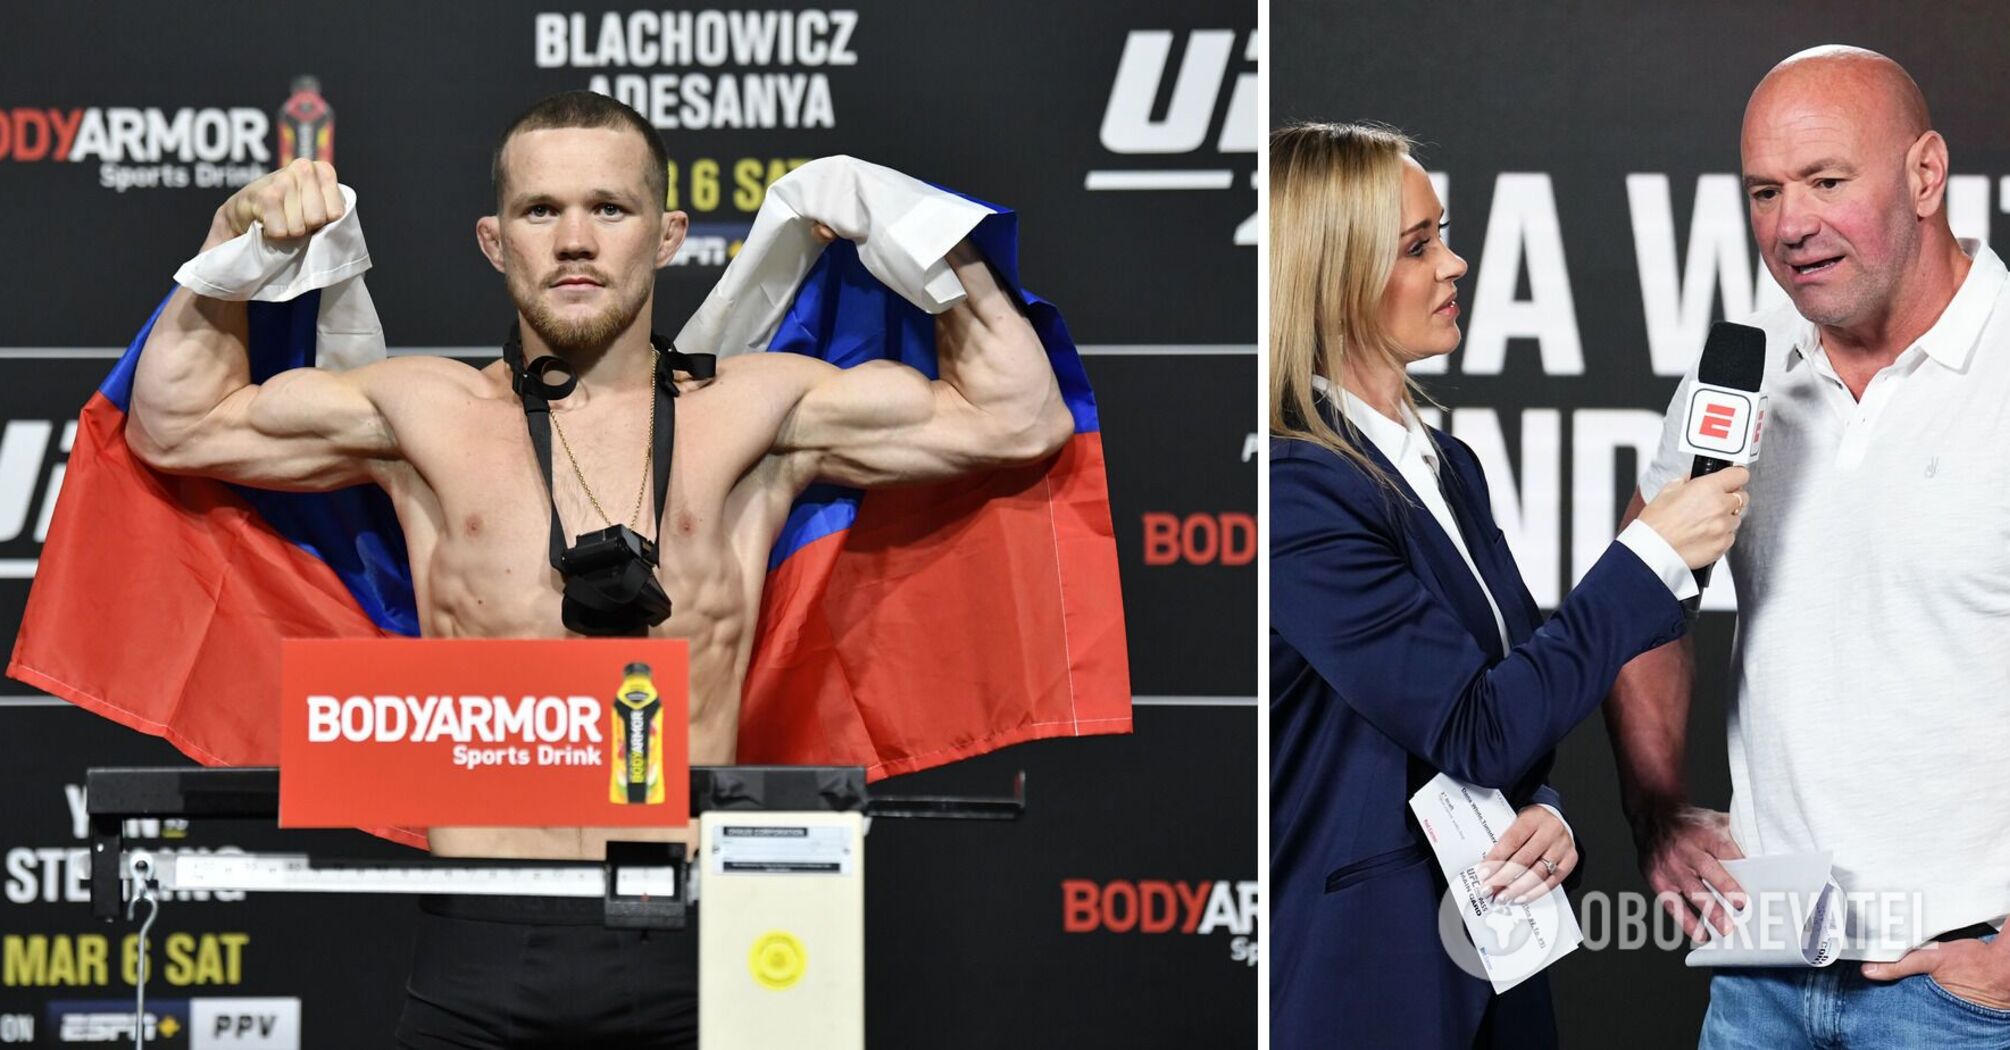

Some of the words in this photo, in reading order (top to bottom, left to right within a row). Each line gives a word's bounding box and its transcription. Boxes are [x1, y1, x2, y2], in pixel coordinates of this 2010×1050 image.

[535, 10, 858, 67] BLACHOWICZ
[0, 107, 271, 162] DYARMOR
[100, 163, 189, 193] Sports
[690, 158, 720, 211] 6
[307, 696, 603, 742] BODYARMOR
[453, 745, 530, 770] Sports
[537, 745, 603, 766] Drink
[630, 710, 645, 783] BODYARMOR
[1061, 879, 1258, 935] BODYAR
[3, 934, 108, 986] MAR
[121, 933, 151, 986] 6
[165, 933, 250, 985] SAT
[0, 1013, 34, 1042] ON
[213, 1014, 277, 1040] PPV
